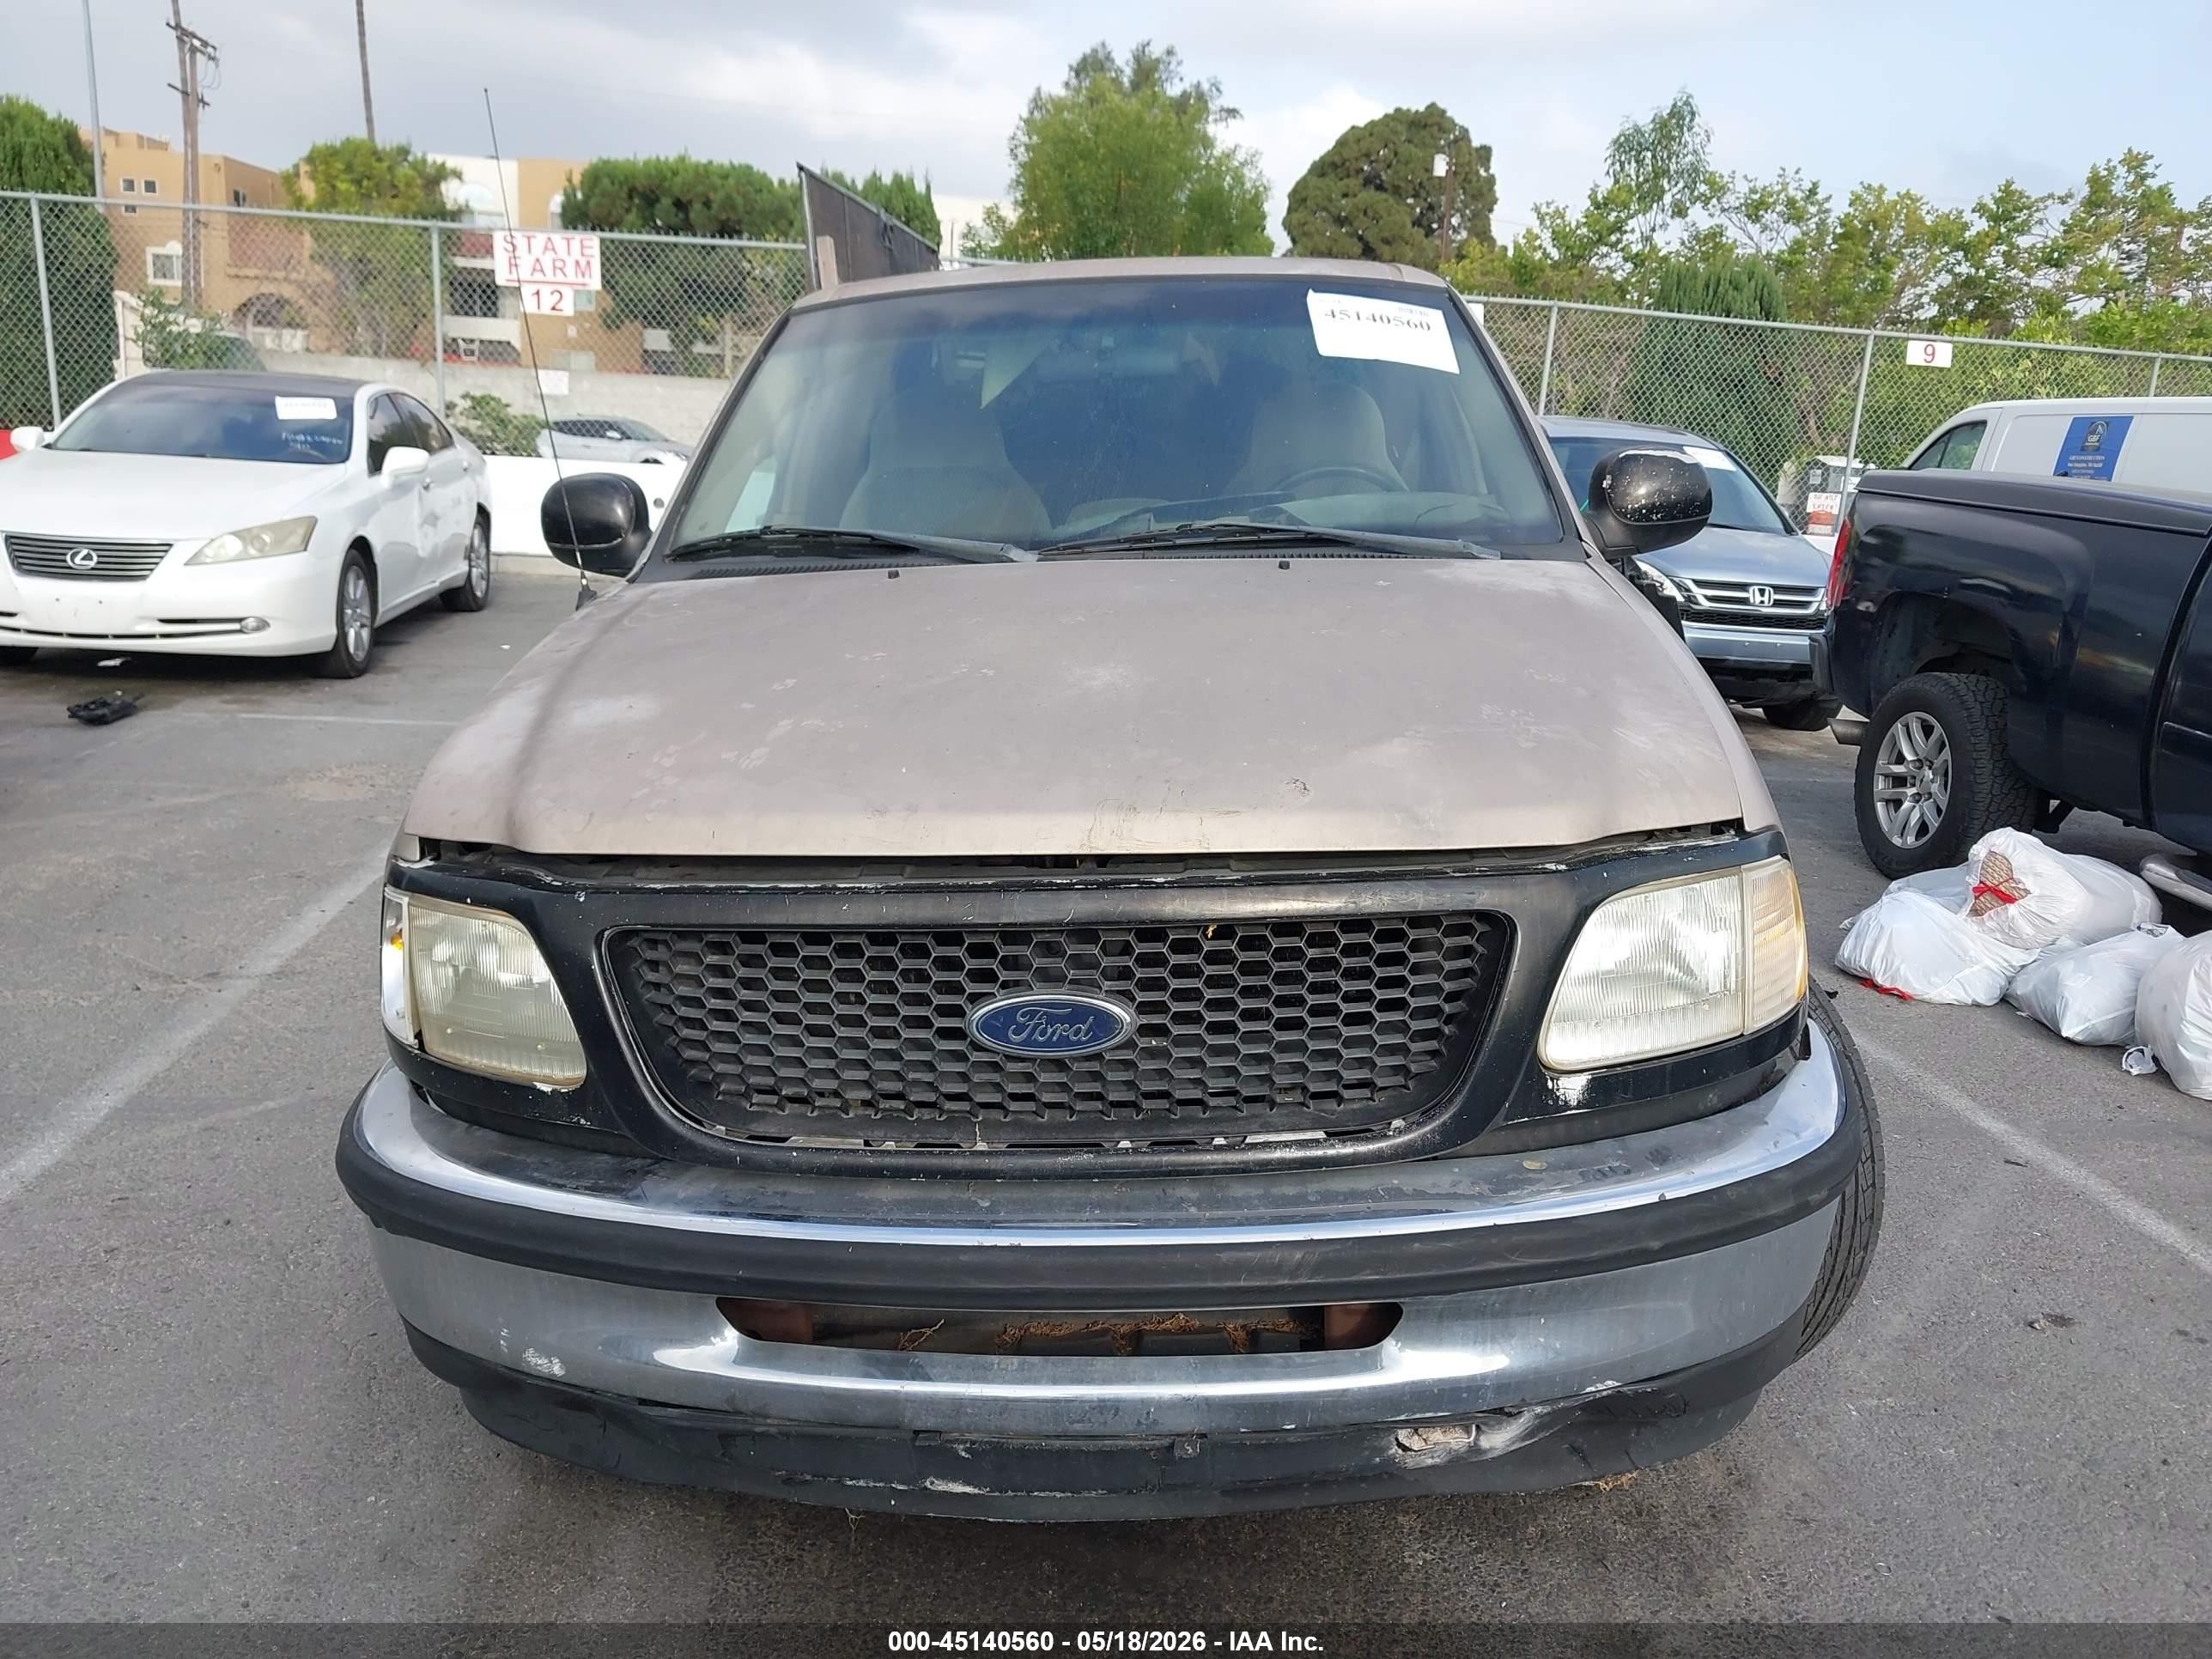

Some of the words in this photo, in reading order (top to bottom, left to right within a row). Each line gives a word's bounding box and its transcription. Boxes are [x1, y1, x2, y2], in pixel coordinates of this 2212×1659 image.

[503, 234, 595, 258] STATE
[507, 256, 592, 279] FARM
[531, 289, 564, 312] 12
[1323, 307, 1432, 332] 45140560
[1923, 343, 1936, 364] 9
[1007, 1006, 1096, 1043] Ford
